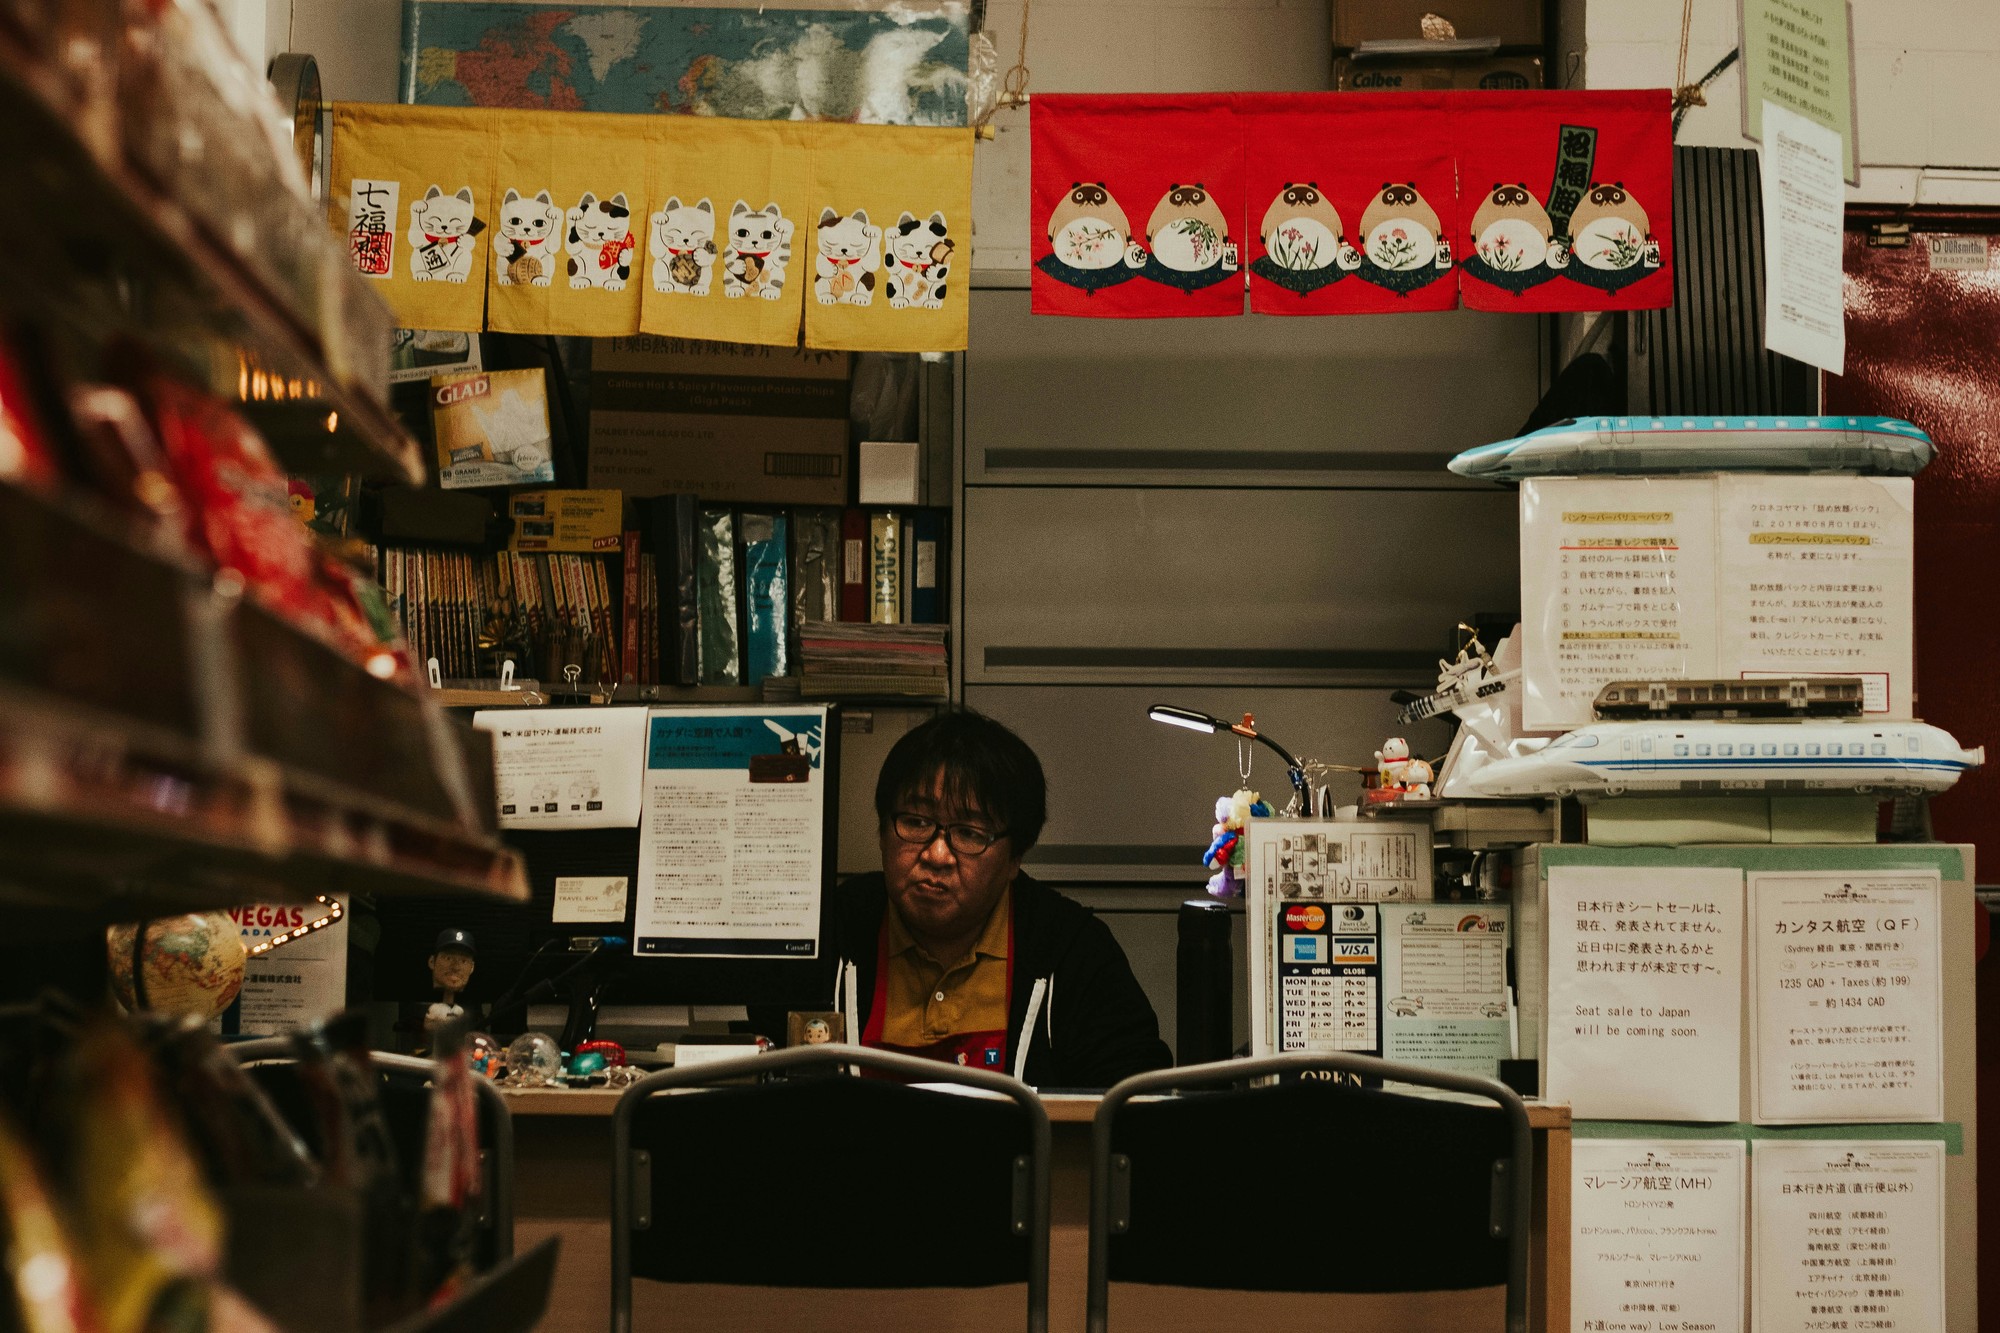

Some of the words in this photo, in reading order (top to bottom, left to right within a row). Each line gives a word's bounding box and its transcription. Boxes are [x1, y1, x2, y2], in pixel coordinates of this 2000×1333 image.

[1352, 73, 1402, 88] Calbee
[436, 379, 488, 405] GLAD
[608, 379, 645, 389] Calbee
[647, 380, 665, 389] Hot
[678, 381, 708, 393] Spicy
[710, 382, 764, 393] Flavoured
[767, 384, 801, 394] Potato
[804, 384, 835, 396] Chips
[1577, 901, 1723, 914] 日本行きシートセールは、
[227, 906, 304, 928] VEGAS
[1286, 913, 1325, 923] MasterCard
[1577, 920, 1723, 933] 現在、発表されてません。
[1340, 945, 1370, 955] VISA
[1577, 942, 1714, 955] 近日中に発表されるかと
[244, 974, 302, 984] ト運輸株式会社
[1780, 978, 1802, 989] 1235
[1807, 978, 1825, 988] CAD
[1840, 997, 1862, 1008] 1434
[1867, 996, 1885, 1007] CAD
[1576, 1005, 1601, 1017] Seat
[1608, 1005, 1633, 1017] sale
[1640, 1006, 1652, 1017] to
[1659, 1005, 1691, 1019] Japan
[1575, 1025, 1600, 1036] will
[1607, 1025, 1620, 1036] be
[1626, 1025, 1665, 1038] coming
[1671, 1027, 1699, 1037] soon.
[988, 1051, 997, 1062] T
[1300, 1070, 1362, 1088] OPEN
[1808, 1211, 1842, 1220] 四川航空
[1807, 1227, 1842, 1236] アモイ航空
[1808, 1243, 1840, 1252] 海南航空
[1811, 1305, 1843, 1315] 香港航空
[1659, 1321, 1678, 1331] Low
[1681, 1321, 1716, 1332] Season
